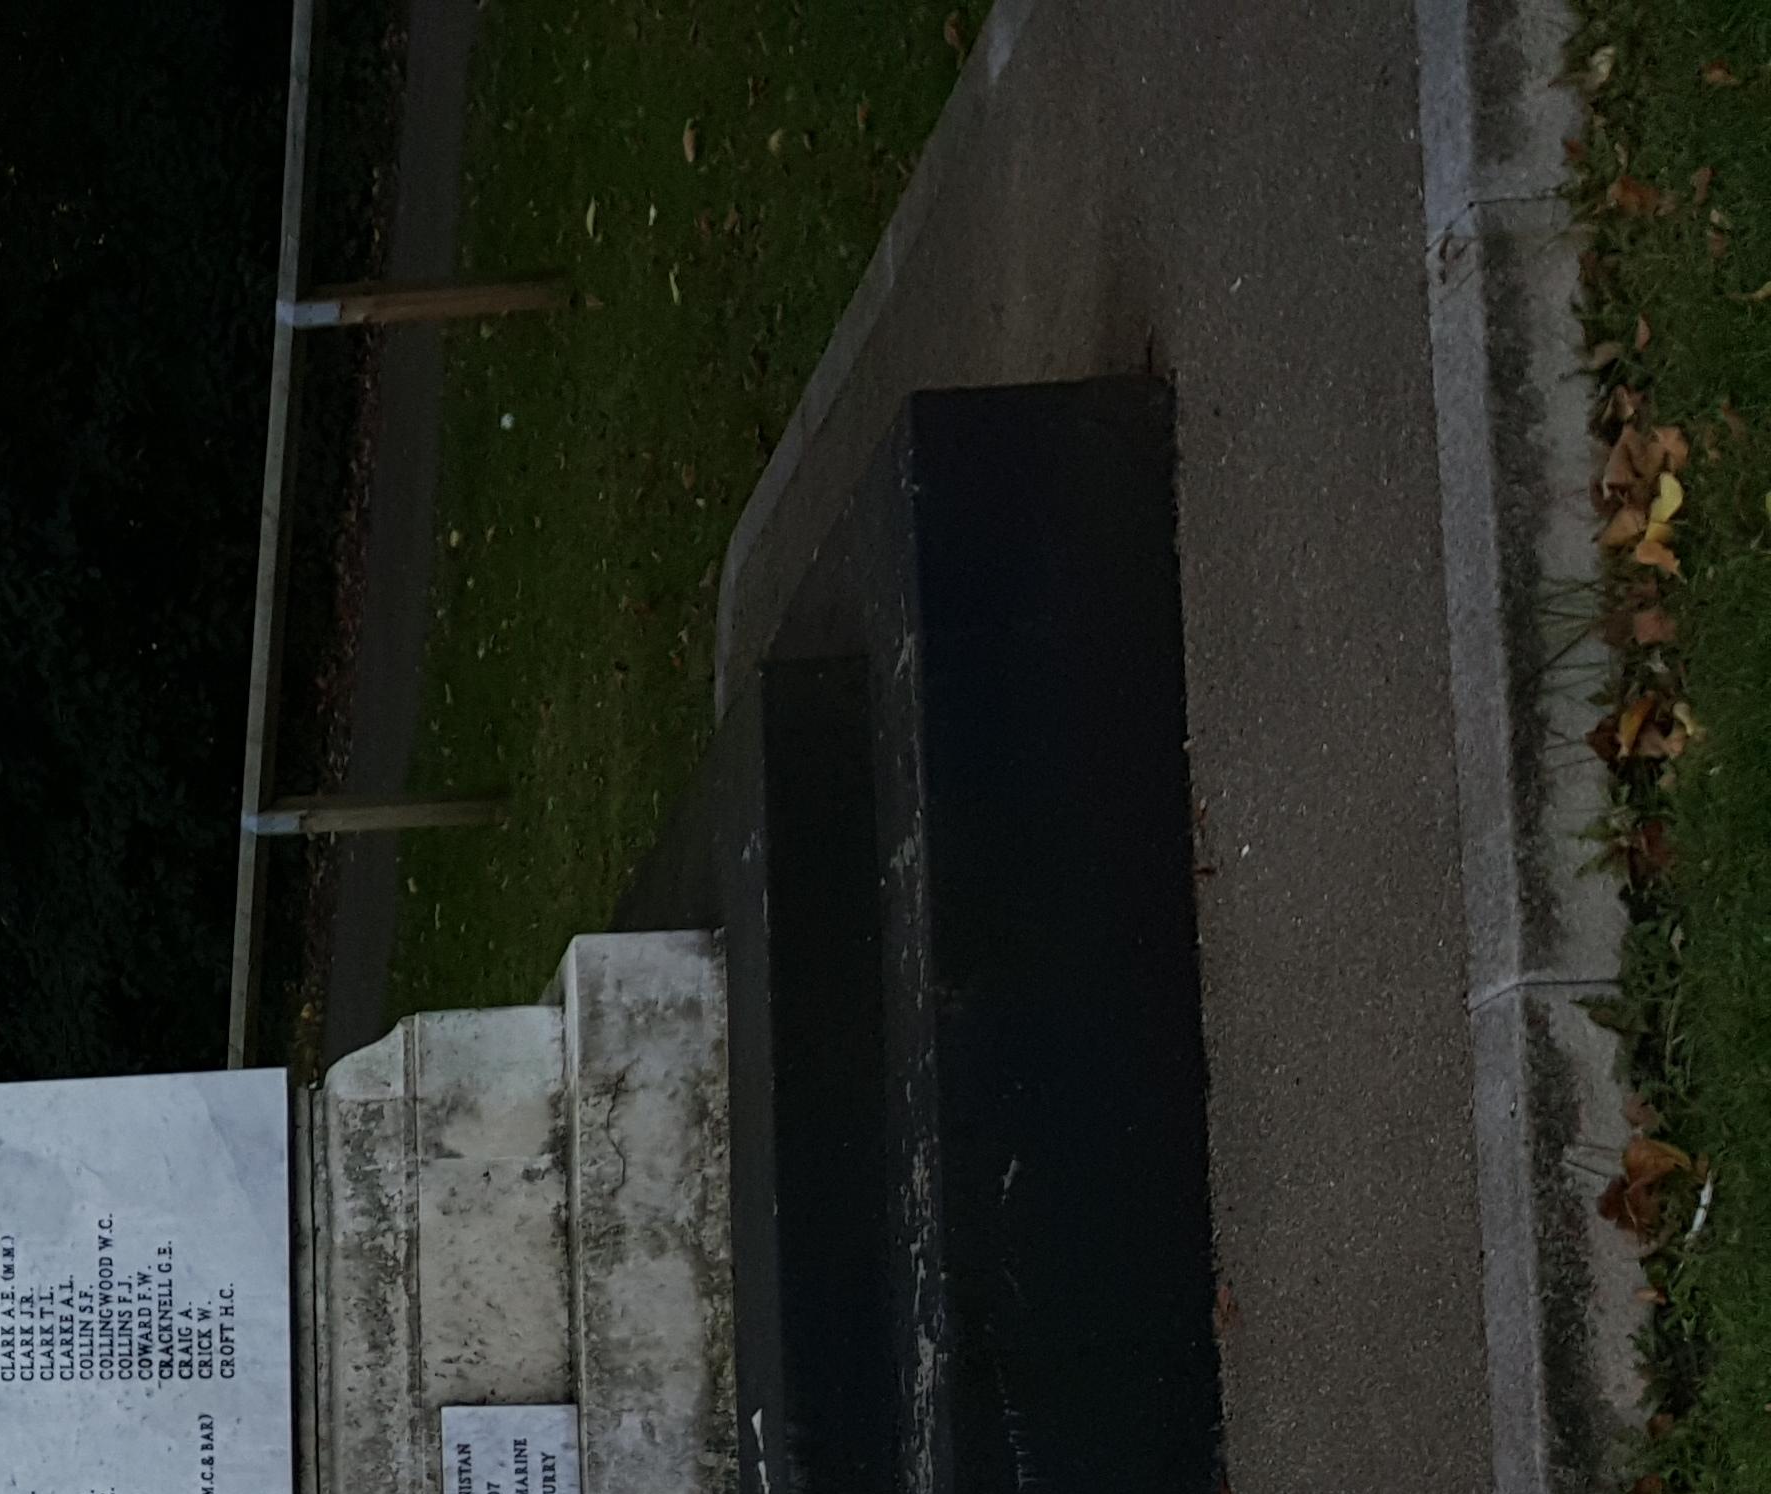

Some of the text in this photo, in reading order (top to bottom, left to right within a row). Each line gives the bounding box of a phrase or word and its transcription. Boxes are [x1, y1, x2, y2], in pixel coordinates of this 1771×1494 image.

[1, 1285, 15, 1320] A.E.
[20, 1288, 34, 1381] CLARK J.R.
[38, 1286, 54, 1381] CLARK T.L.
[59, 1275, 74, 1381] CLARKE A.L.
[79, 1285, 94, 1380] COLLIN S.F.
[98, 1213, 114, 1380] COLLINGWOOD W.C.
[118, 1275, 133, 1380] COLLINS F.J.
[137, 1266, 153, 1381] COWARD F.W.
[157, 1241, 174, 1382] CRACKNELL G.E.
[178, 1302, 194, 1380] CRAIG A.
[197, 1301, 213, 1379] CRICK W.
[219, 1283, 235, 1379] CROFT H.C.
[1, 1326, 15, 1382] CLARK
